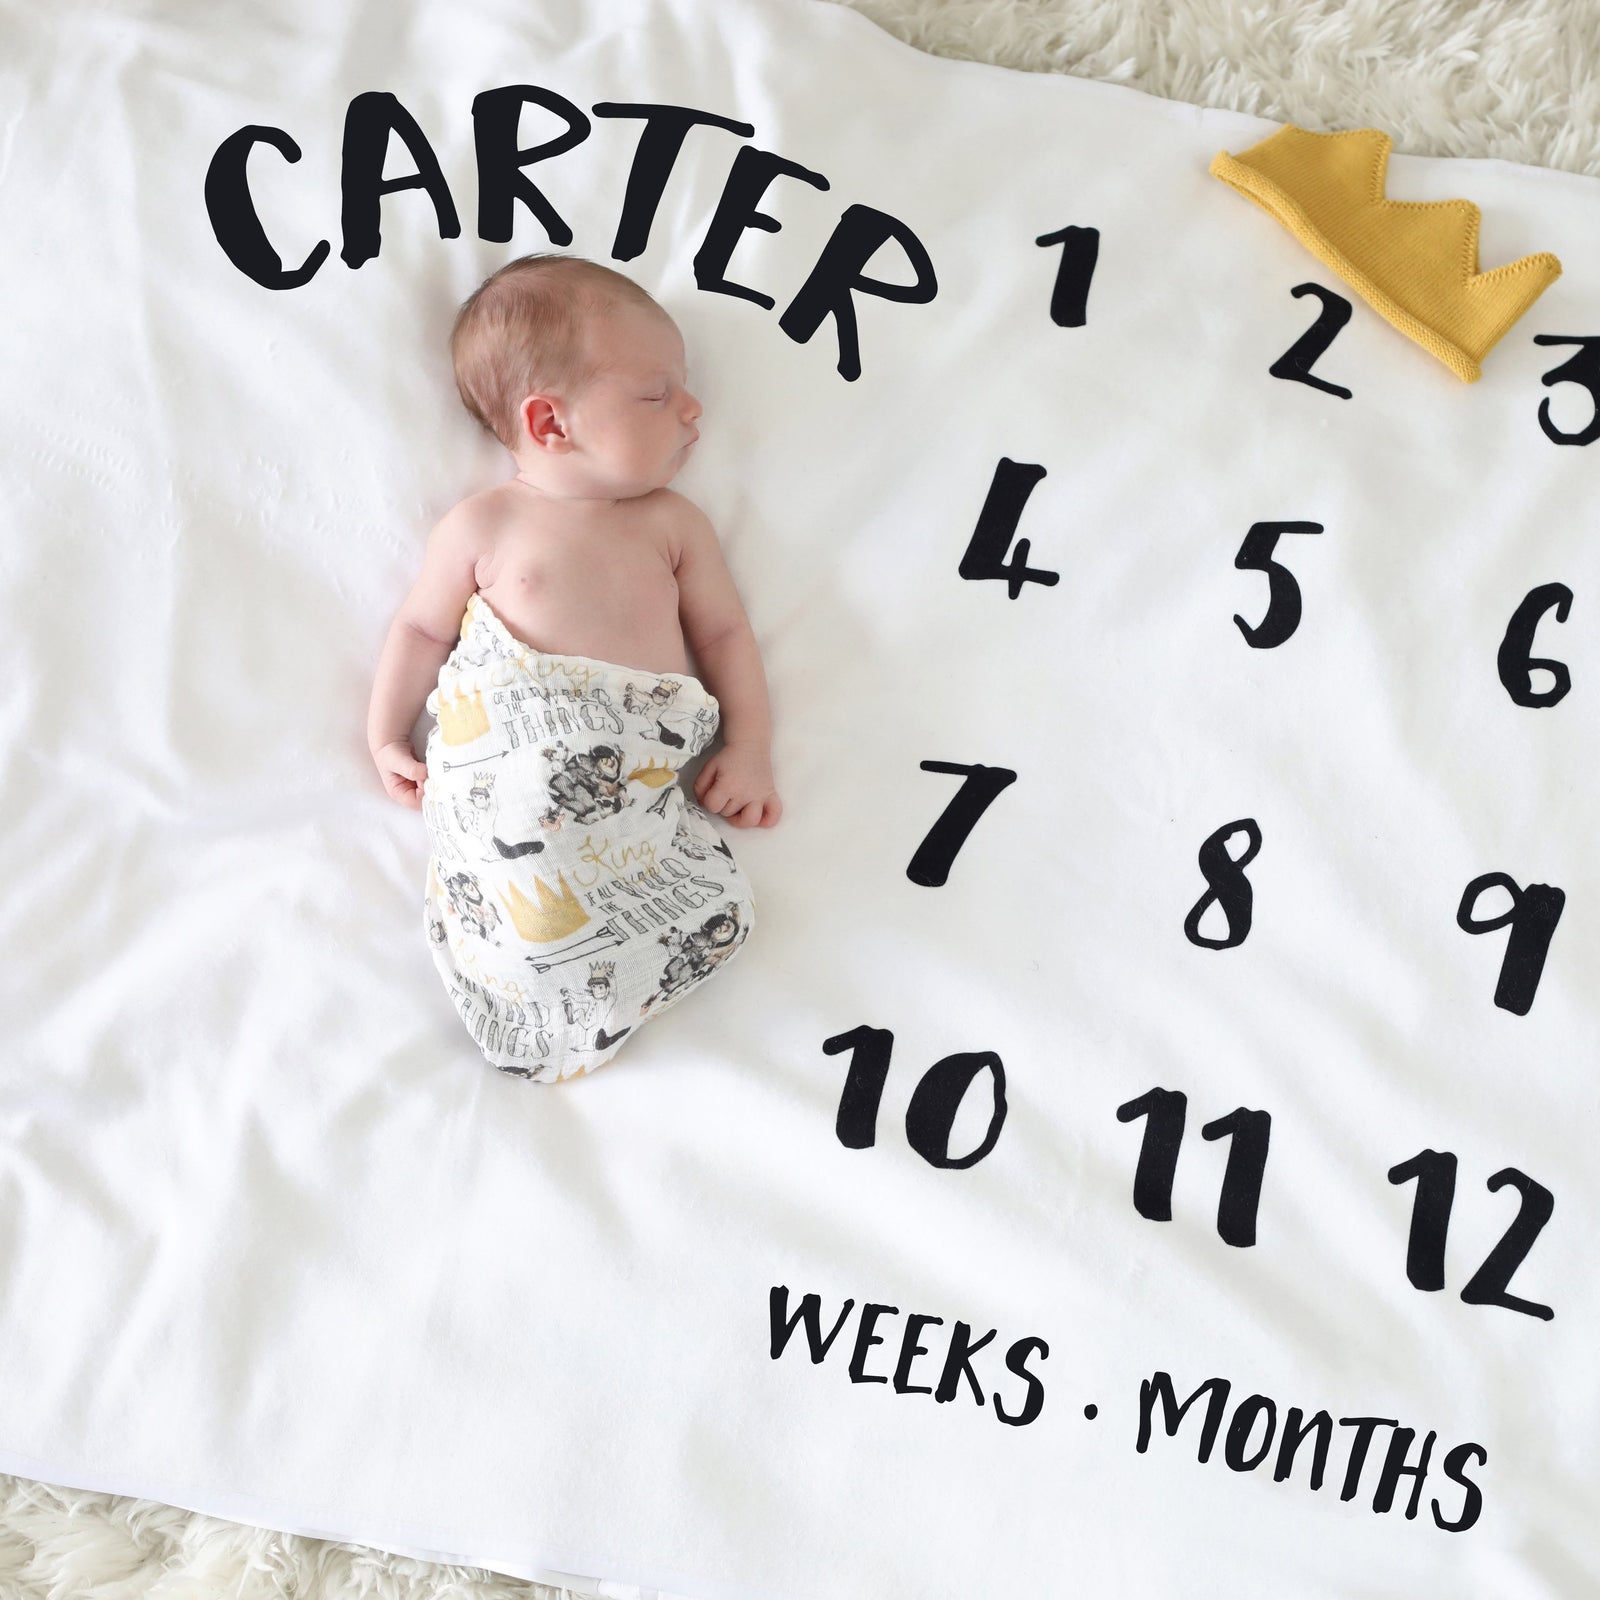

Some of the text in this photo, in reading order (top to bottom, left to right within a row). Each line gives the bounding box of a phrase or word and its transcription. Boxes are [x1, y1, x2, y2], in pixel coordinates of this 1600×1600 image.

[204, 84, 939, 383] CARTER
[1035, 225, 1100, 328] 1
[1268, 282, 1353, 400] 2
[1533, 334, 1600, 447] 3
[958, 456, 1060, 601] 4
[1233, 520, 1325, 649] 5
[1497, 582, 1574, 709] 6
[501, 704, 625, 750] THINGS
[572, 834, 661, 887] King
[611, 857, 692, 900] WILD
[905, 760, 1018, 888] 7
[1183, 818, 1263, 951] 8
[605, 874, 725, 941] THINGS
[1456, 871, 1566, 1017] 9
[822, 1024, 1008, 1170] 10
[1116, 1086, 1272, 1248] 11
[1387, 1148, 1555, 1322] 12
[769, 1284, 1050, 1427] WEEKS
